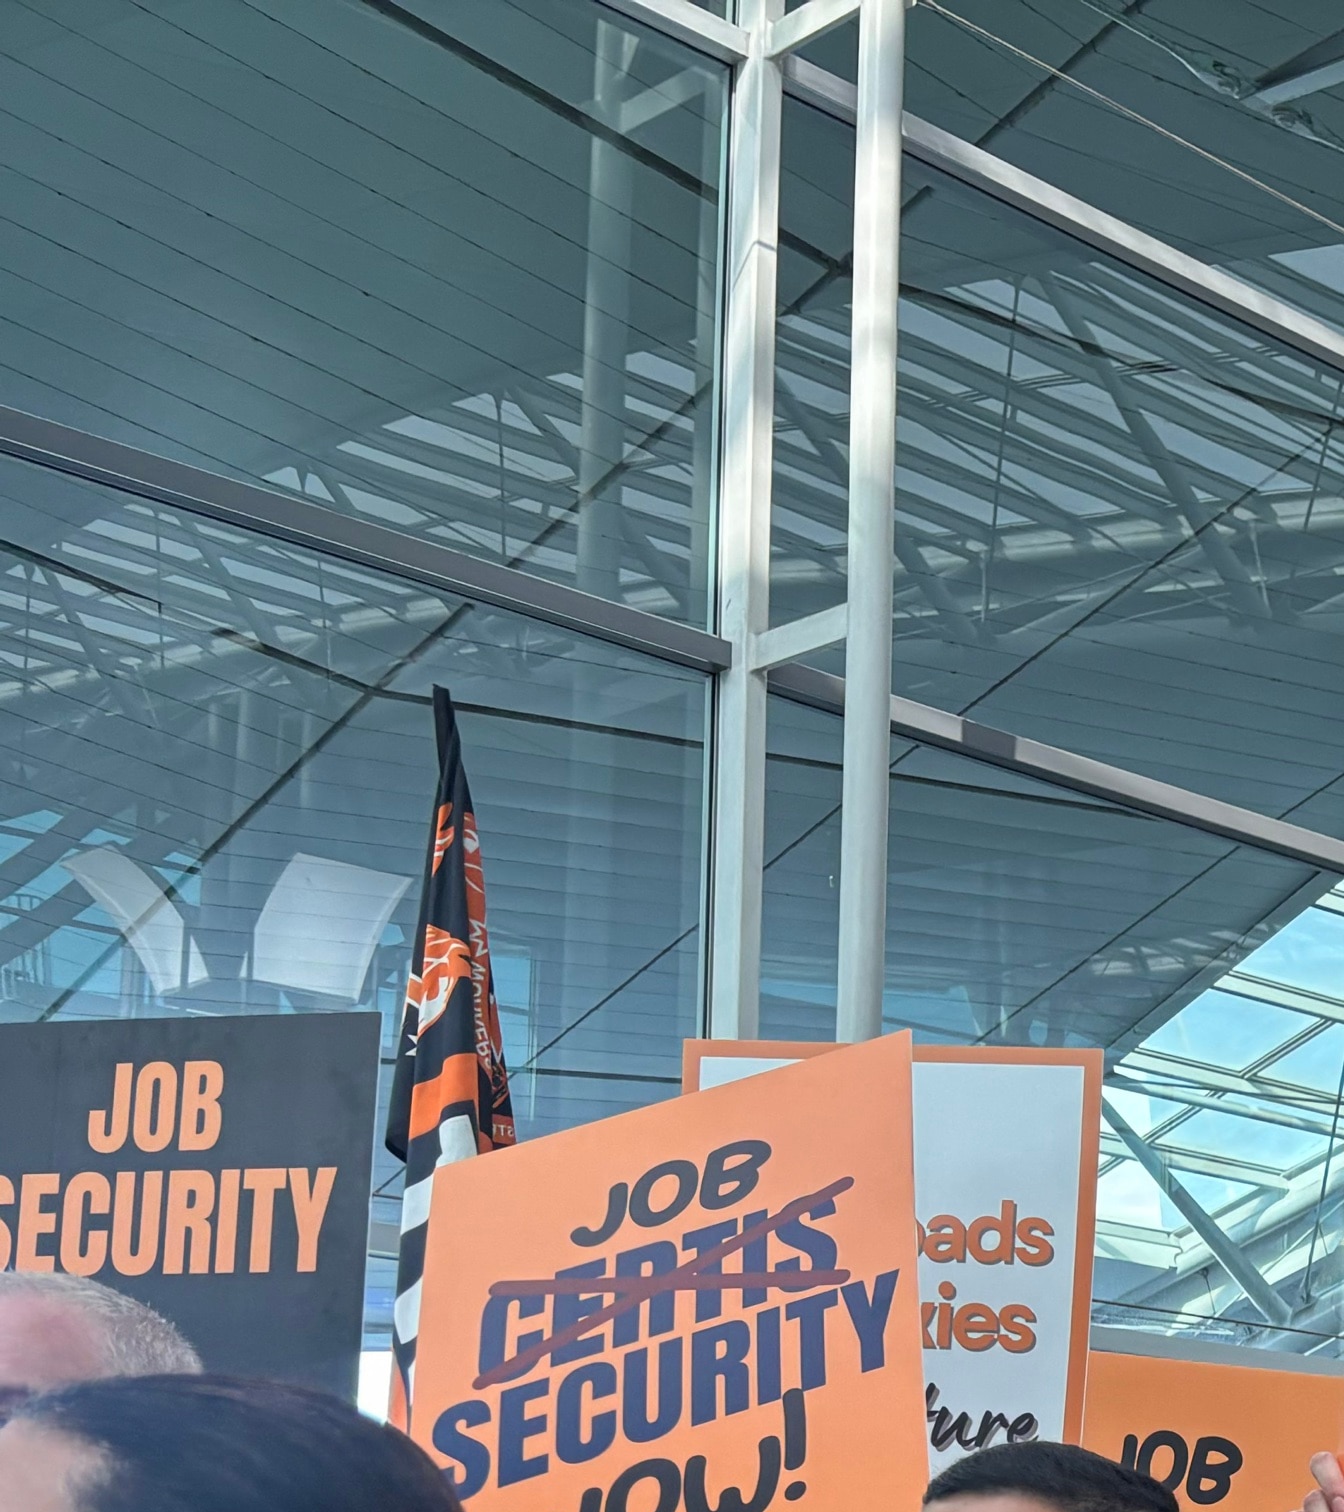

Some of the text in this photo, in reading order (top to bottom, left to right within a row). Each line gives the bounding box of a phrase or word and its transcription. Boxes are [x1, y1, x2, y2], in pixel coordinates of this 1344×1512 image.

[88, 1060, 224, 1154] JOB
[0, 1166, 338, 1276] ECURITY
[570, 1140, 772, 1247] JOB
[478, 1196, 840, 1384] CERTIS
[432, 1269, 900, 1503] SECURITY
